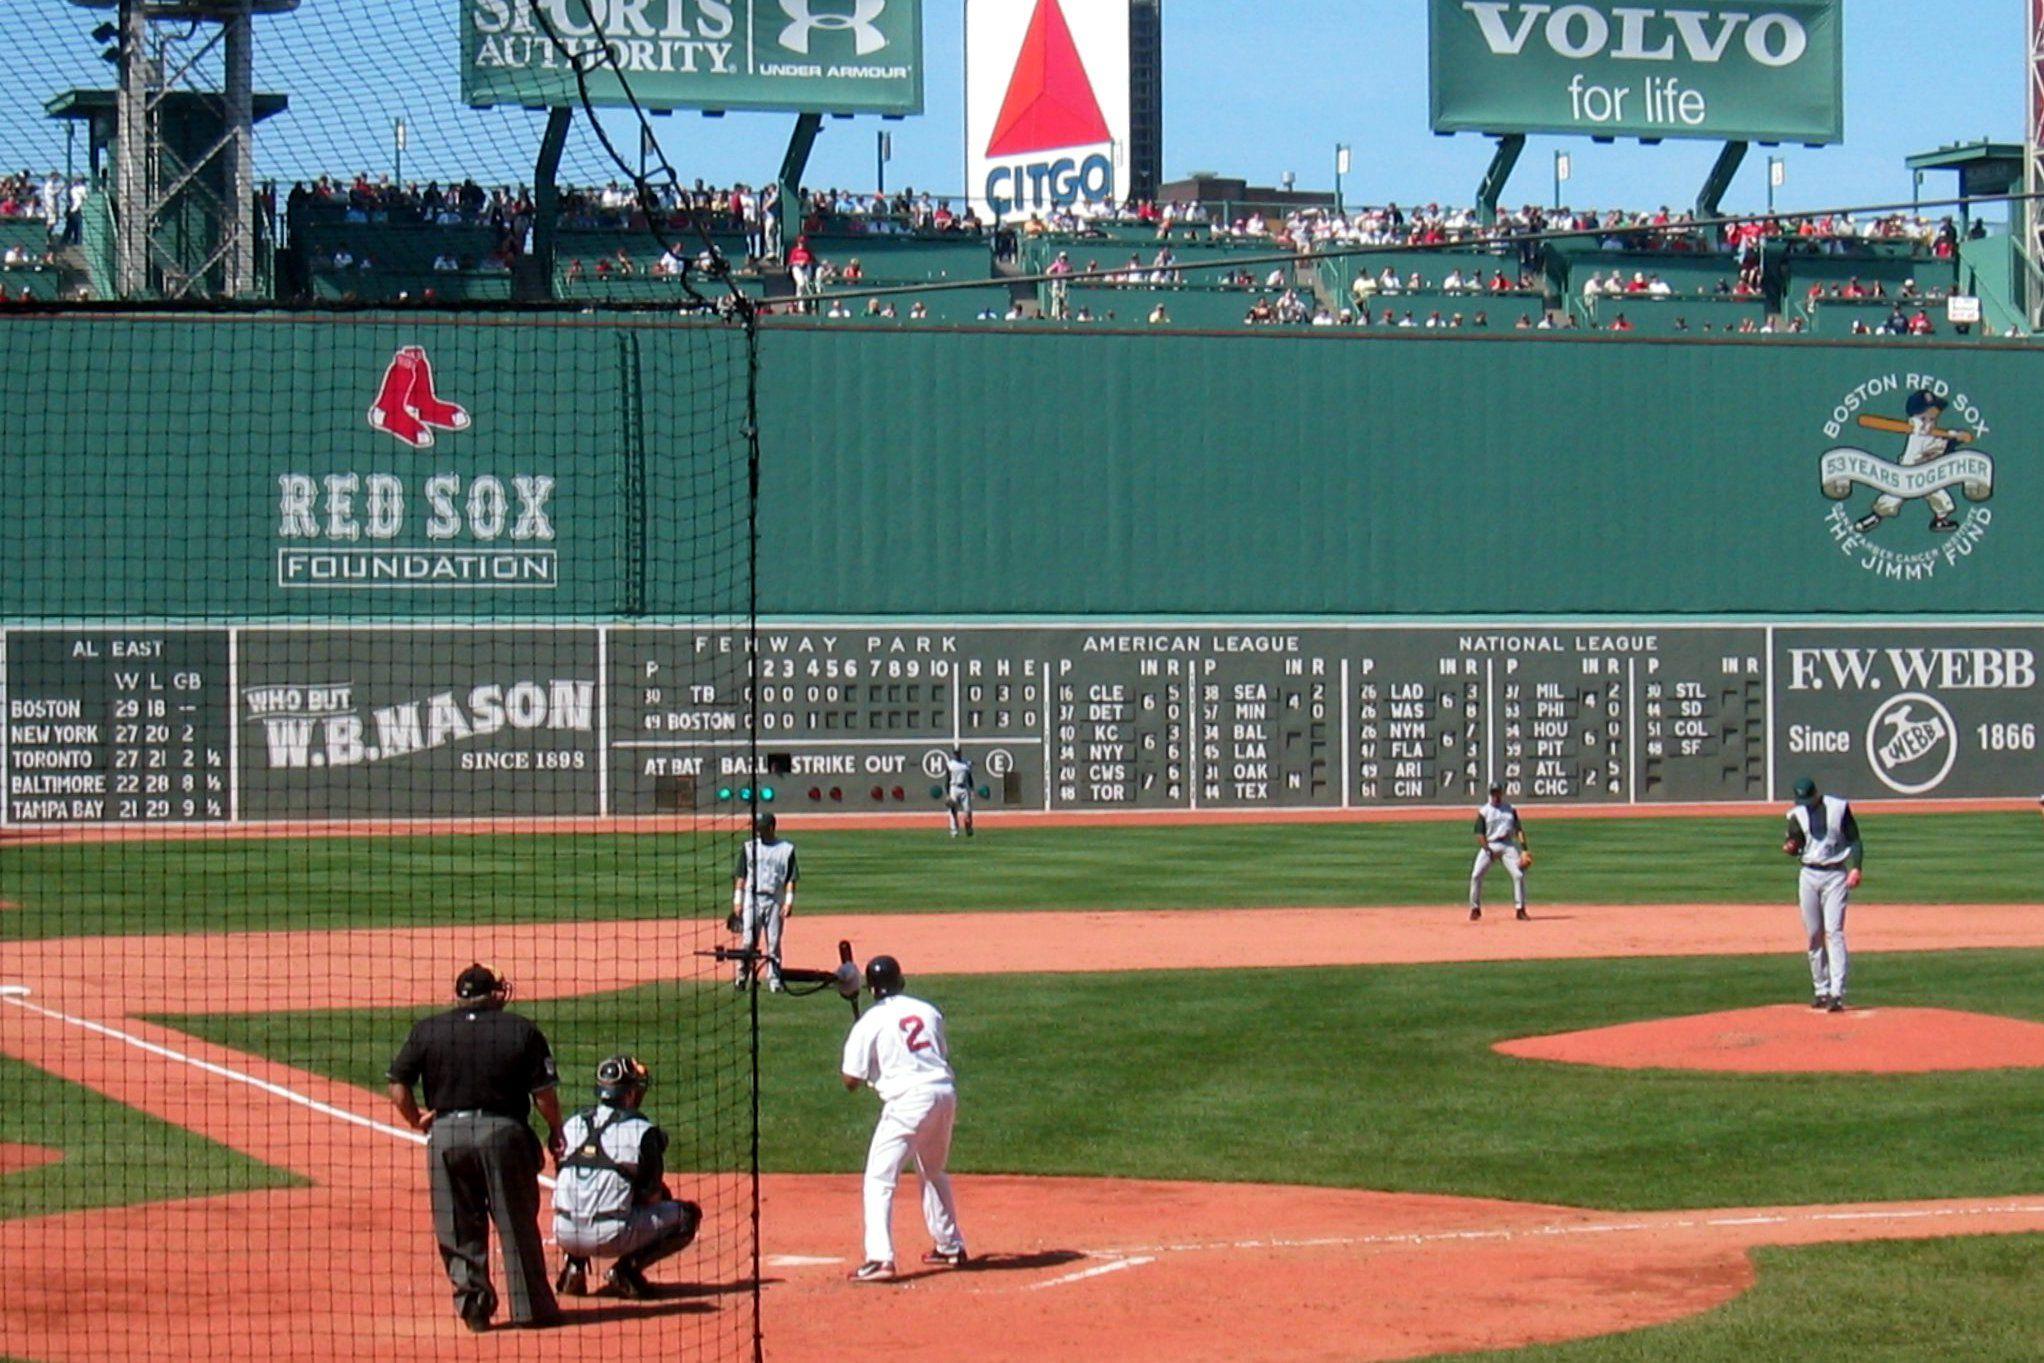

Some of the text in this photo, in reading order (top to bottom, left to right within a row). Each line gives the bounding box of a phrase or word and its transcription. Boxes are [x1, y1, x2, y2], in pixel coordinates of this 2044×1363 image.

[1462, 1, 1807, 67] VOLVO
[760, 63, 907, 79] UNDER ARMOUR
[1568, 74, 1706, 125] for life
[986, 153, 1111, 216] CITGO
[1823, 373, 1898, 439] BOSTON
[1953, 394, 1990, 438] SOX
[1827, 457, 1988, 489] 53 YEARS TOGETHER
[278, 472, 555, 542] RED SOX
[1824, 505, 1859, 556] THE
[1861, 556, 1935, 581] JIMMY
[1945, 507, 1991, 567] FUND
[288, 555, 547, 578] FOUNDATION
[73, 641, 164, 657] AL EAST
[867, 636, 957, 653] PARK
[1083, 636, 1299, 652] AMERICAN LEAGUE
[1459, 636, 1657, 651] NATIONAL LEAGUE
[646, 660, 1035, 678] P 2 3 4 5 6 7 8 9 10 R H E
[1060, 659, 1179, 676] P IN R
[1204, 659, 1324, 675] P IN R
[1362, 659, 1477, 675] P IN R
[1507, 658, 1619, 674] P IN R
[1648, 657, 1758, 674] P IN R
[1886, 648, 2035, 690] WEBB
[115, 673, 201, 690] W L GB
[690, 686, 1035, 703] TB 0 0
[1089, 685, 1123, 701] CLE
[1234, 684, 1266, 700] SEA
[1313, 684, 1323, 700] 2
[1391, 684, 1424, 700] LAD
[1536, 683, 1620, 699] MIL 2
[1676, 682, 1706, 698] STL
[246, 688, 352, 713] WHO BUT
[1143, 694, 1155, 710] 6
[1288, 694, 1300, 710] 4
[1584, 694, 1596, 708] 4
[1681, 701, 1701, 716] SD
[11, 700, 165, 718] BOSTON 29 18
[1089, 704, 1179, 720] DET 0
[1236, 704, 1323, 720] MIN 0
[1391, 703, 1424, 719] WAS
[1537, 702, 1564, 717] PHI
[667, 713, 736, 730] BOSTON
[1024, 712, 1036, 726] 0
[1674, 721, 1708, 737] COL
[11, 725, 194, 744] NEW YORK 27 20 2
[1095, 725, 1179, 741] KC 3
[1234, 725, 1266, 740] BAL
[1390, 723, 1425, 739] NYM
[1534, 722, 1568, 737] HOU
[1789, 723, 2035, 752] Since 1866
[1144, 734, 1155, 750] 6
[1537, 741, 1564, 756] PIT
[1681, 739, 1702, 755] SF
[1889, 723, 1937, 760] WEBB
[1090, 744, 1179, 761] NYY 6
[1234, 743, 1266, 759] LAA
[1392, 742, 1423, 758] FLA
[12, 750, 194, 768] TORONTO 27 21 2
[461, 751, 585, 770] SINCE 1898
[644, 758, 667, 775] AT
[672, 758, 703, 775] BAT
[791, 756, 857, 774] STRIKE
[865, 755, 906, 773] OUT
[1089, 765, 1179, 781] CWS 6
[1234, 764, 1268, 779] OAK
[1395, 762, 1421, 778] ARI
[1536, 761, 1566, 776] ATL
[11, 774, 194, 793] BALTIMORE 22 28 8
[1288, 774, 1300, 789] N
[1394, 781, 1422, 796] CIN
[1534, 780, 1568, 795] CHC
[1090, 785, 1124, 800] TOR
[1169, 784, 1180, 799] 4
[1235, 783, 1267, 798] TEX
[12, 801, 68, 819] TAMPA
[72, 801, 104, 819] BAY
[119, 801, 137, 819] 21
[182, 801, 194, 819] 9
[899, 1014, 931, 1053] 2
